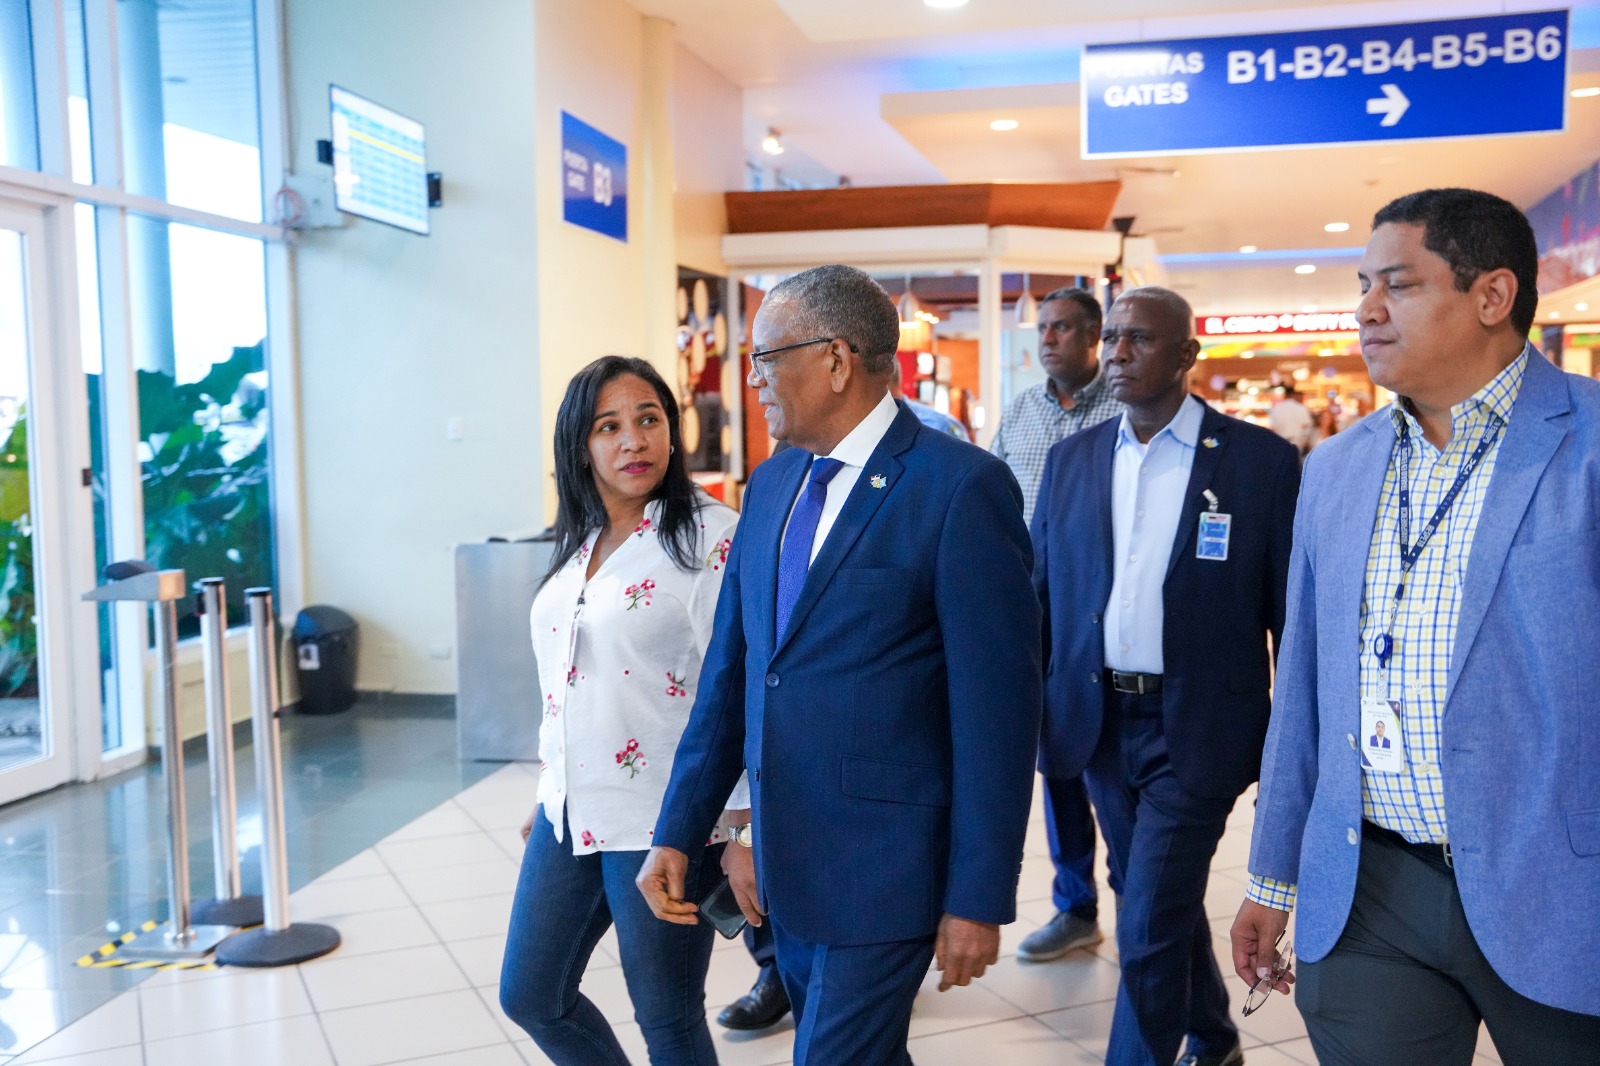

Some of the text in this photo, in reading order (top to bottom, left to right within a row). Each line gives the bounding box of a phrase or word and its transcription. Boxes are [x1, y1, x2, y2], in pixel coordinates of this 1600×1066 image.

[1227, 26, 1562, 84] B1-B2-B4-B5-B6
[1104, 81, 1188, 107] GATES
[593, 162, 612, 207] B3
[1416, 524, 1435, 548] RESPETO
